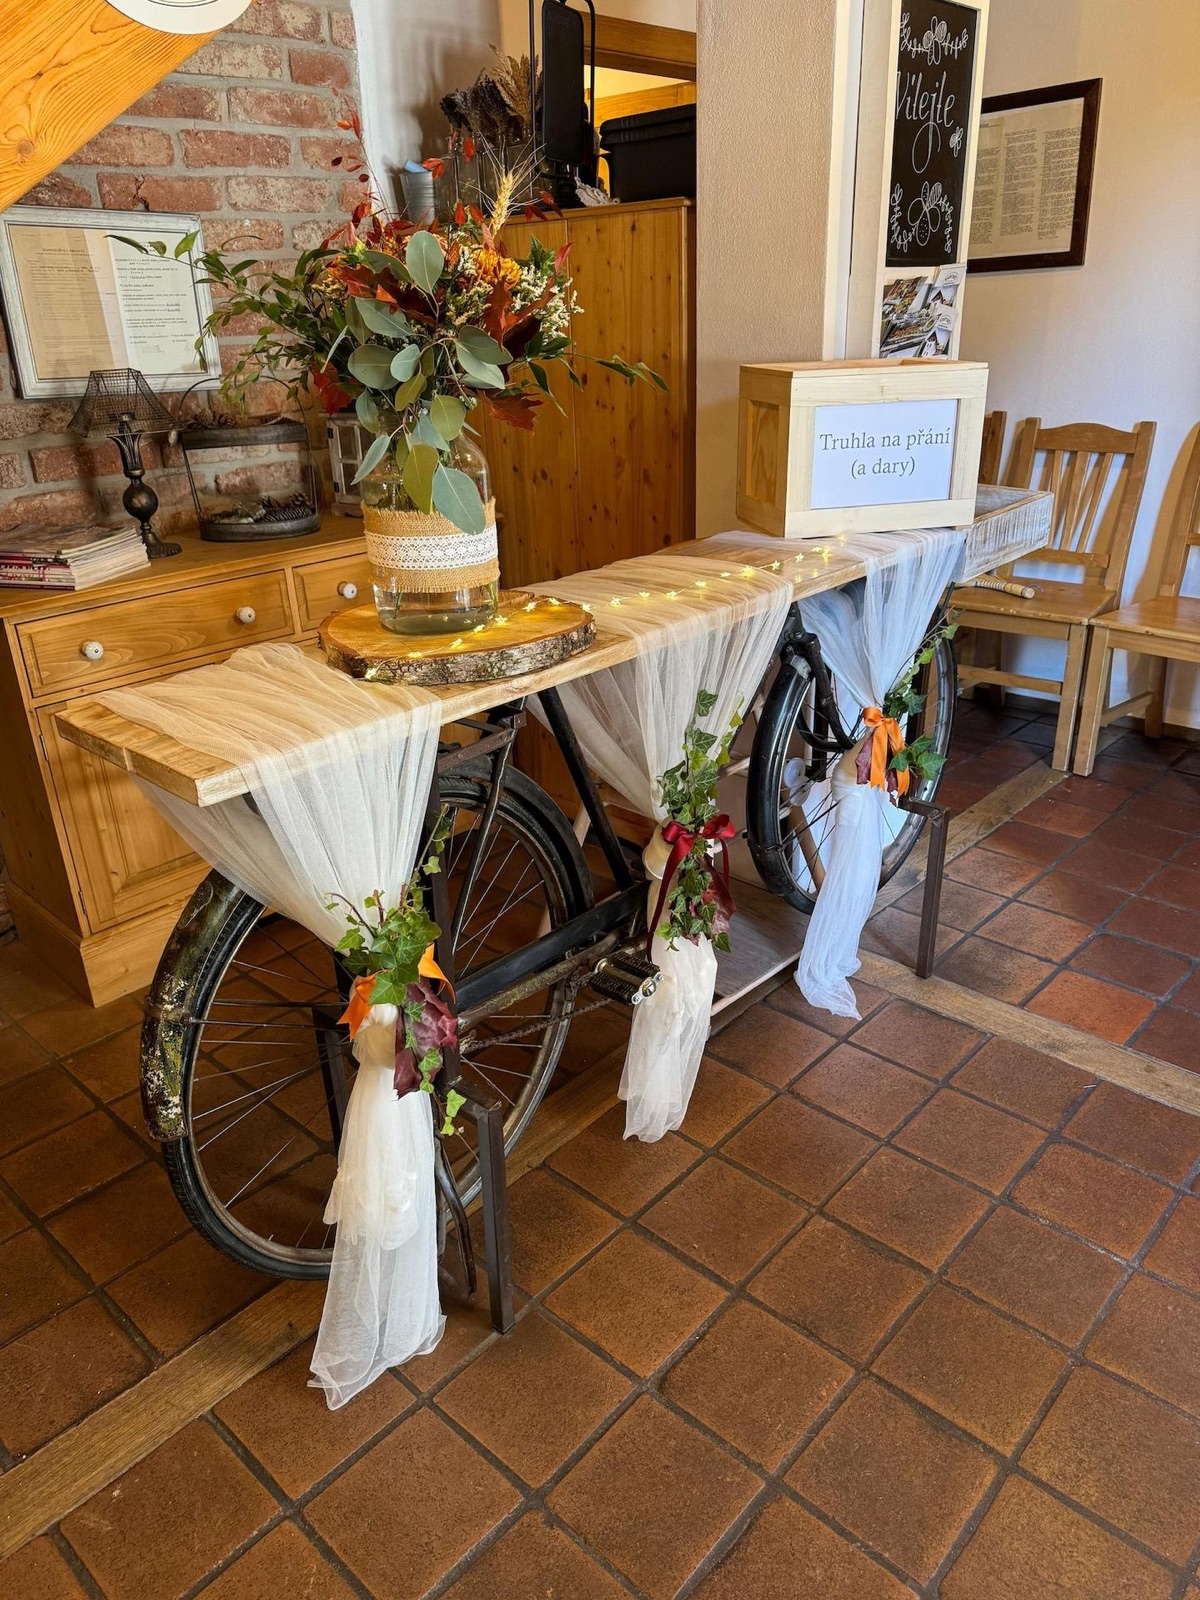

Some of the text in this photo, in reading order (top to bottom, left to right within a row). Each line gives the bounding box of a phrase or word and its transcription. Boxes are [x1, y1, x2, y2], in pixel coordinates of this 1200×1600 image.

[819, 428, 951, 451] Truhla na přání
[850, 456, 916, 479] (a dary)
